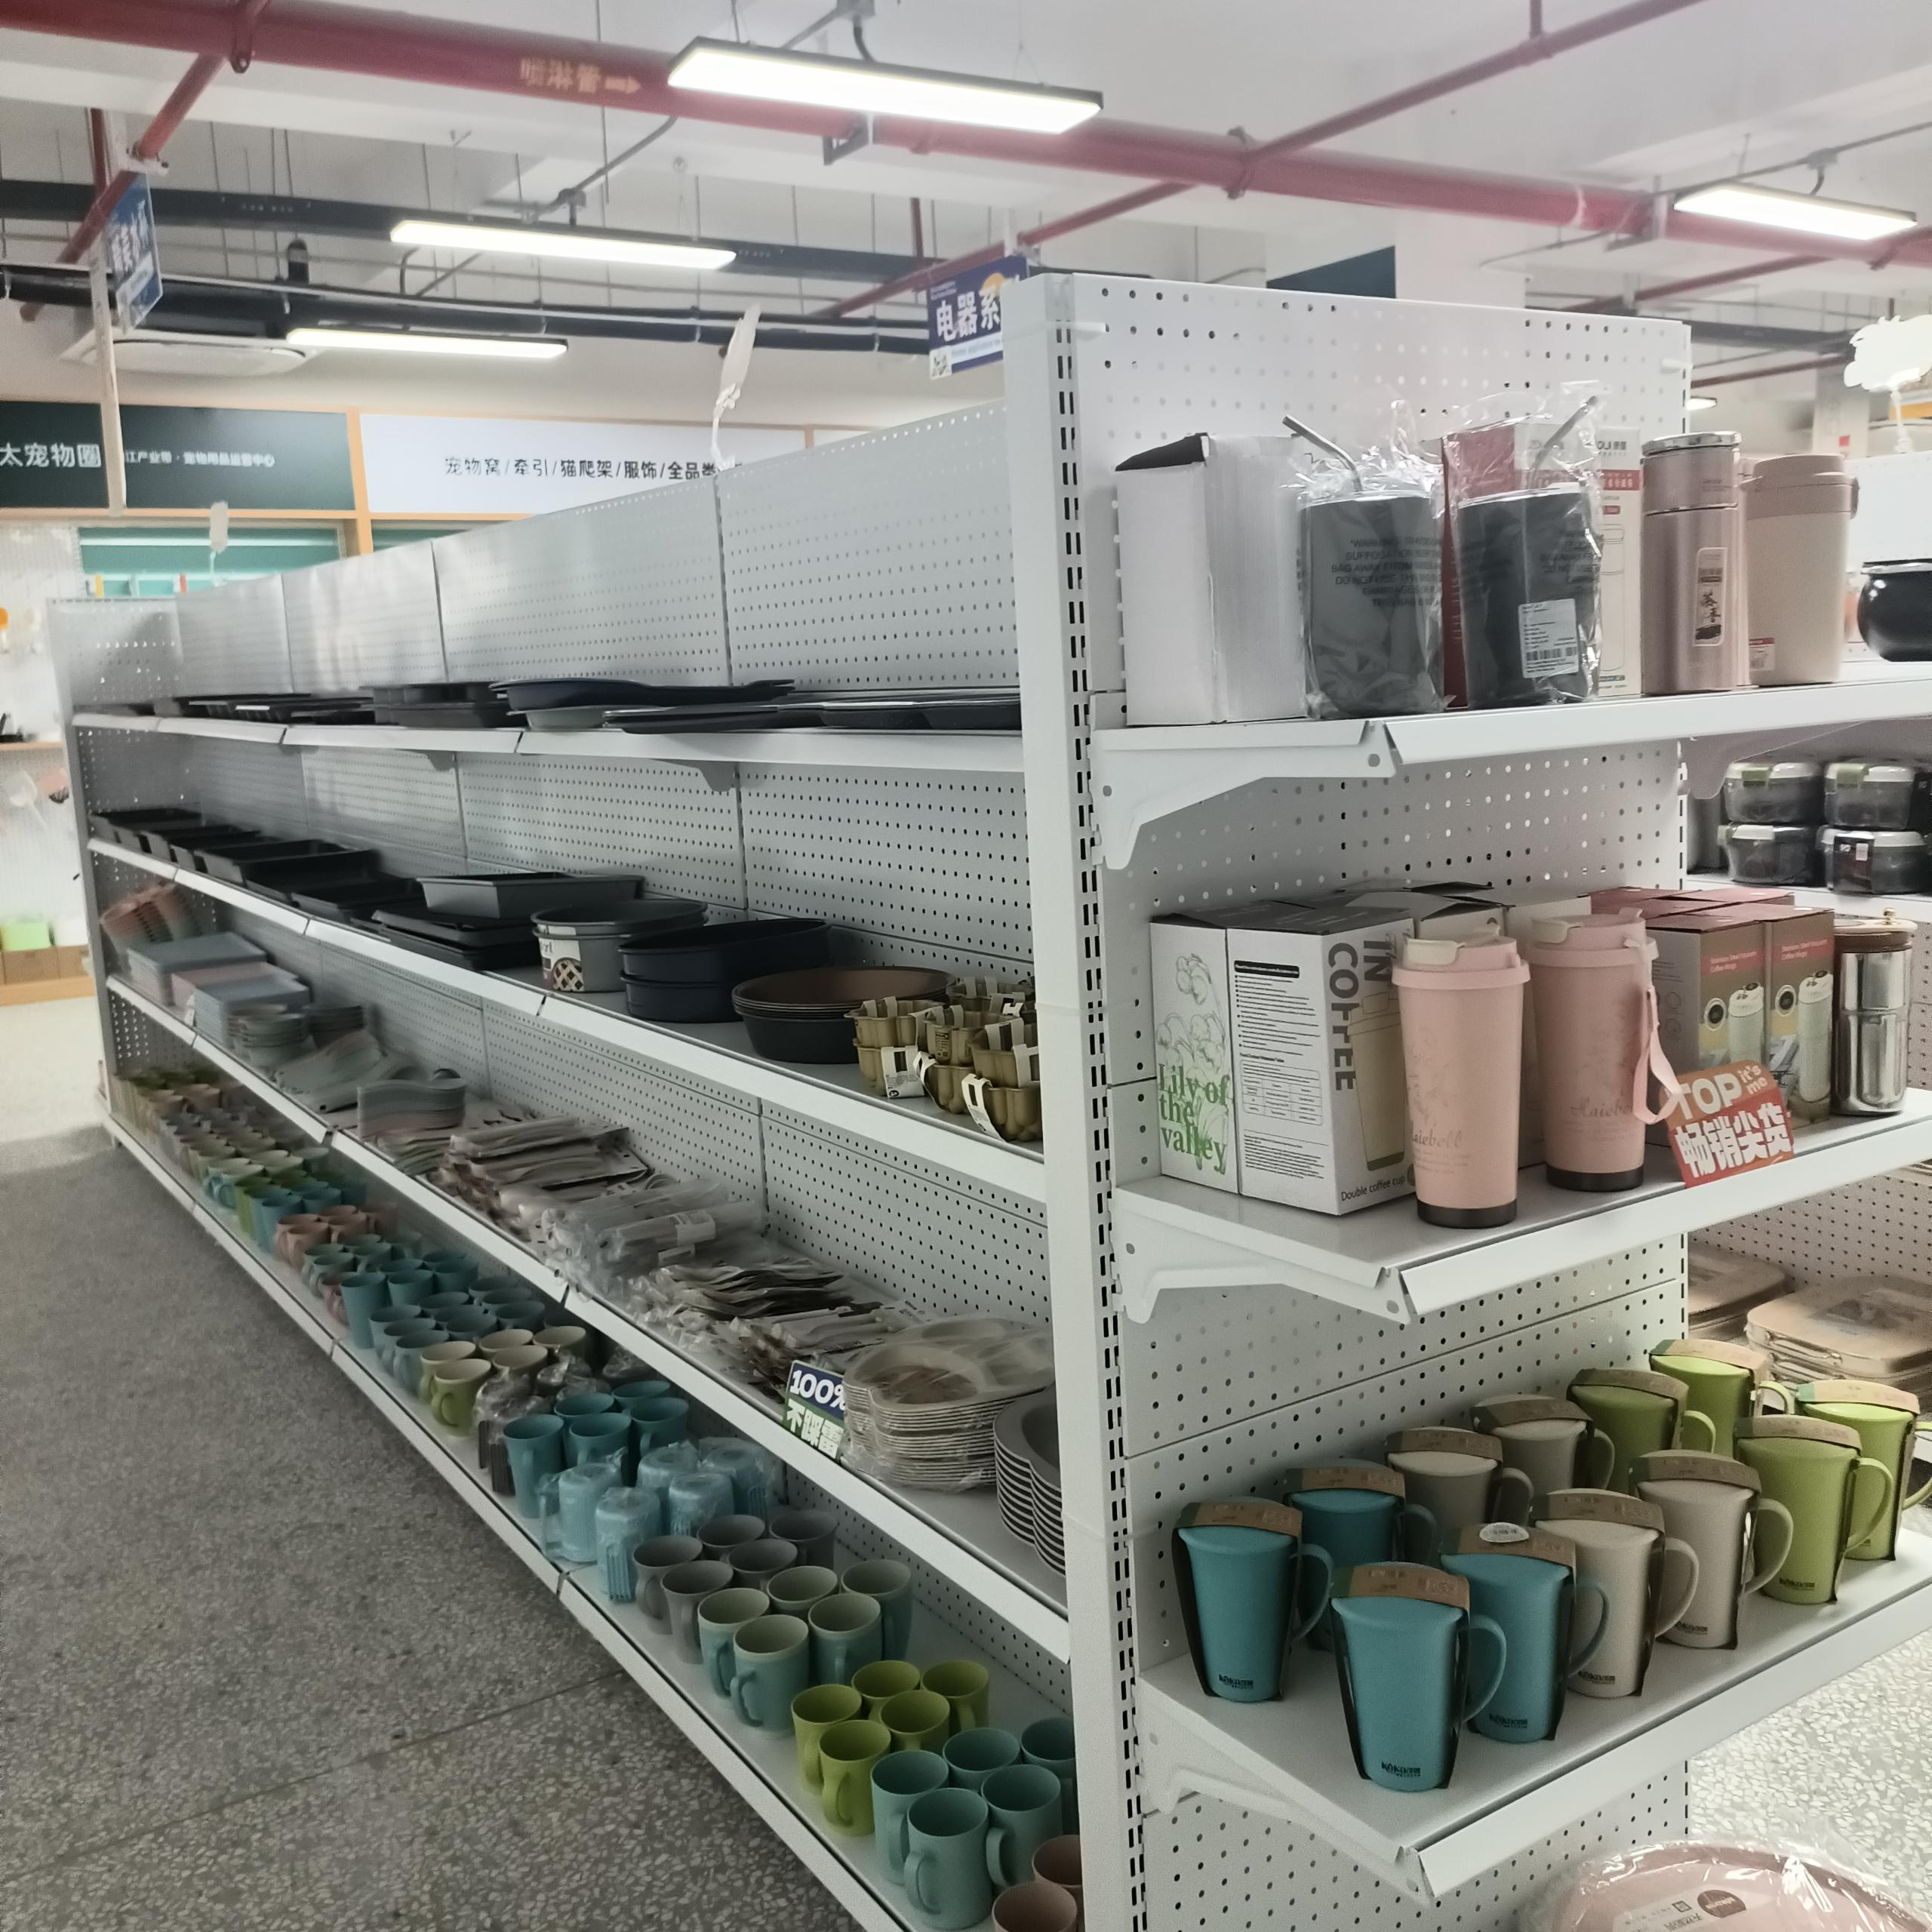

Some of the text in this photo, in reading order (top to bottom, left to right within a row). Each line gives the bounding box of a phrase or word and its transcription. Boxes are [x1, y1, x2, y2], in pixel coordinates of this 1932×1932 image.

[936, 287, 1002, 342] 电器系
[1363, 940, 1392, 981] IN
[1328, 943, 1360, 1091] COFFEE
[1158, 1063, 1198, 1099] Lily
[1205, 1075, 1230, 1105] of
[1159, 1087, 1195, 1124] the
[1675, 1073, 1742, 1120] TOP
[1160, 1124, 1228, 1175] valley
[1340, 1175, 1406, 1201] Double coffee cup
[789, 1370, 845, 1411] 100%
[786, 1398, 844, 1459] 不踩雷
